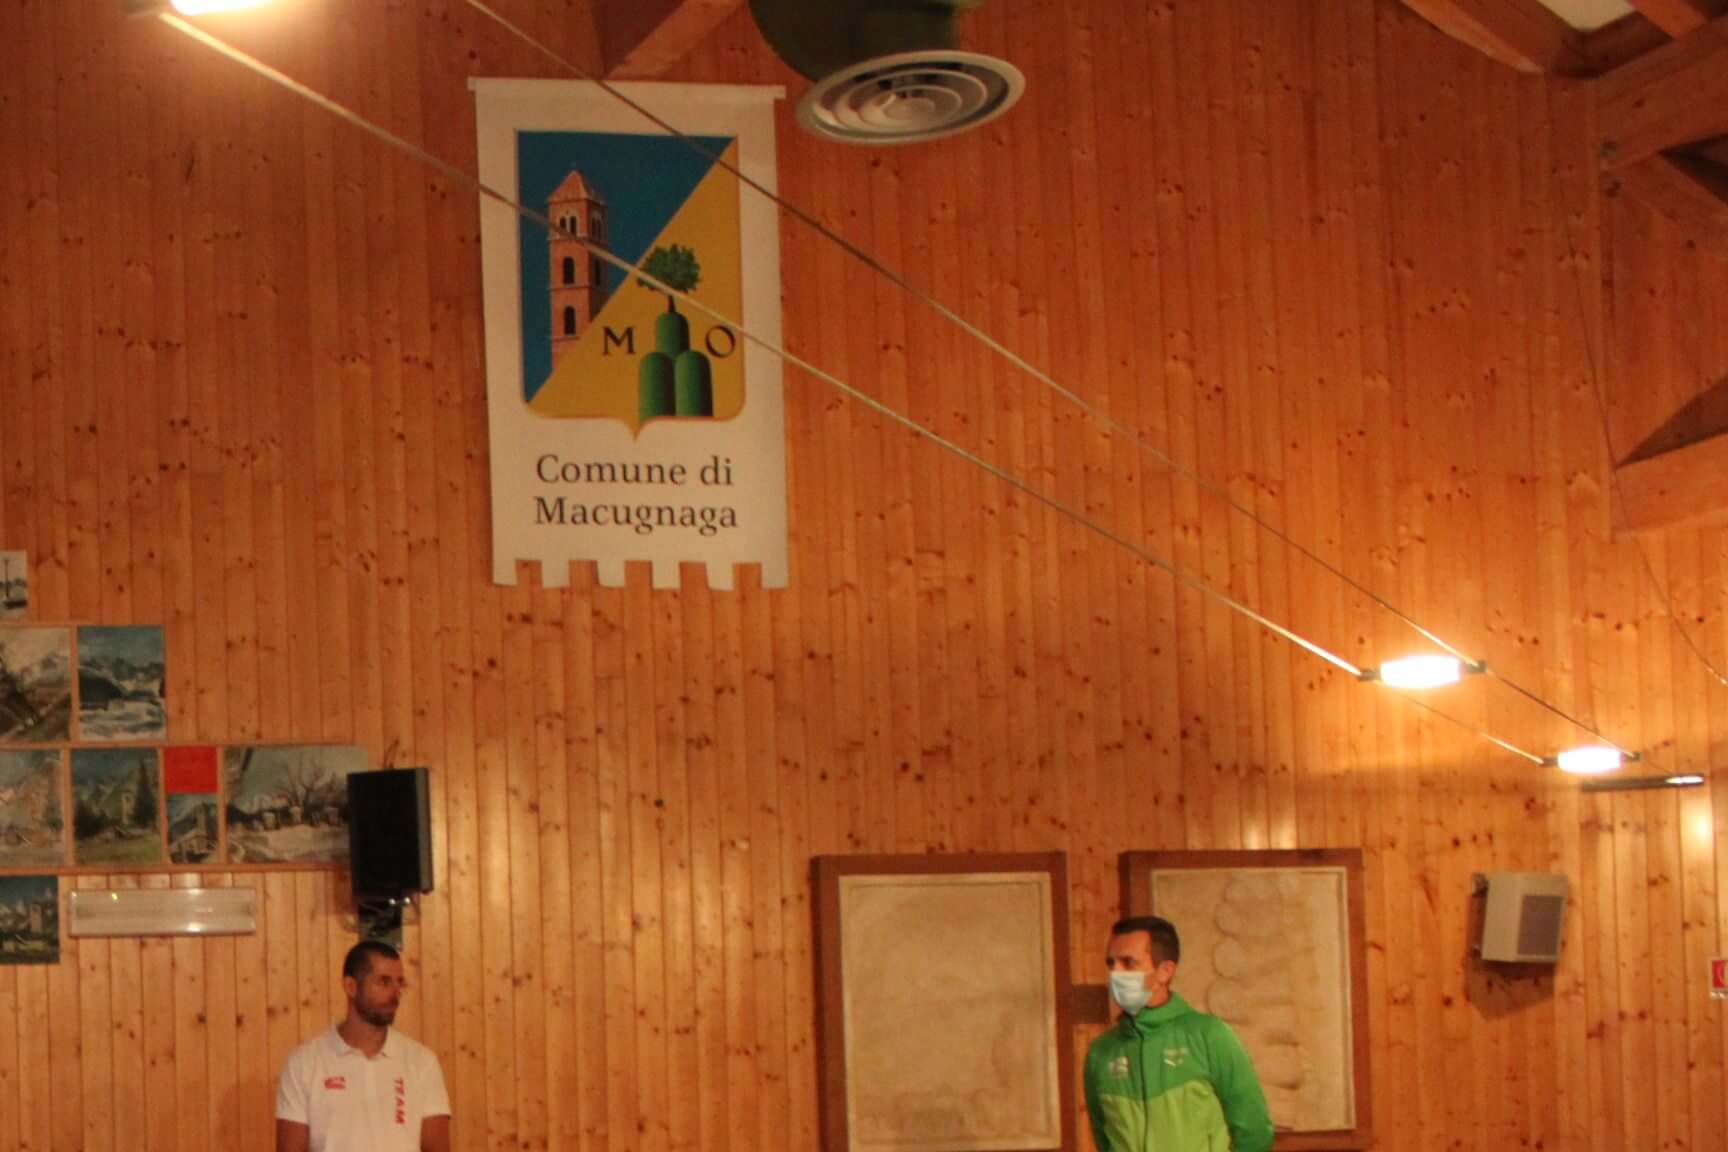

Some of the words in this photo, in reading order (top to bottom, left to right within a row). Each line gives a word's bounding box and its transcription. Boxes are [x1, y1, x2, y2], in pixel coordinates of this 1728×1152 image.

[601, 326, 637, 355] M
[704, 325, 737, 359] O
[536, 454, 688, 486] Comune
[699, 455, 734, 486] di
[534, 496, 739, 537] Macugnaga
[393, 1077, 406, 1126] TEAM
